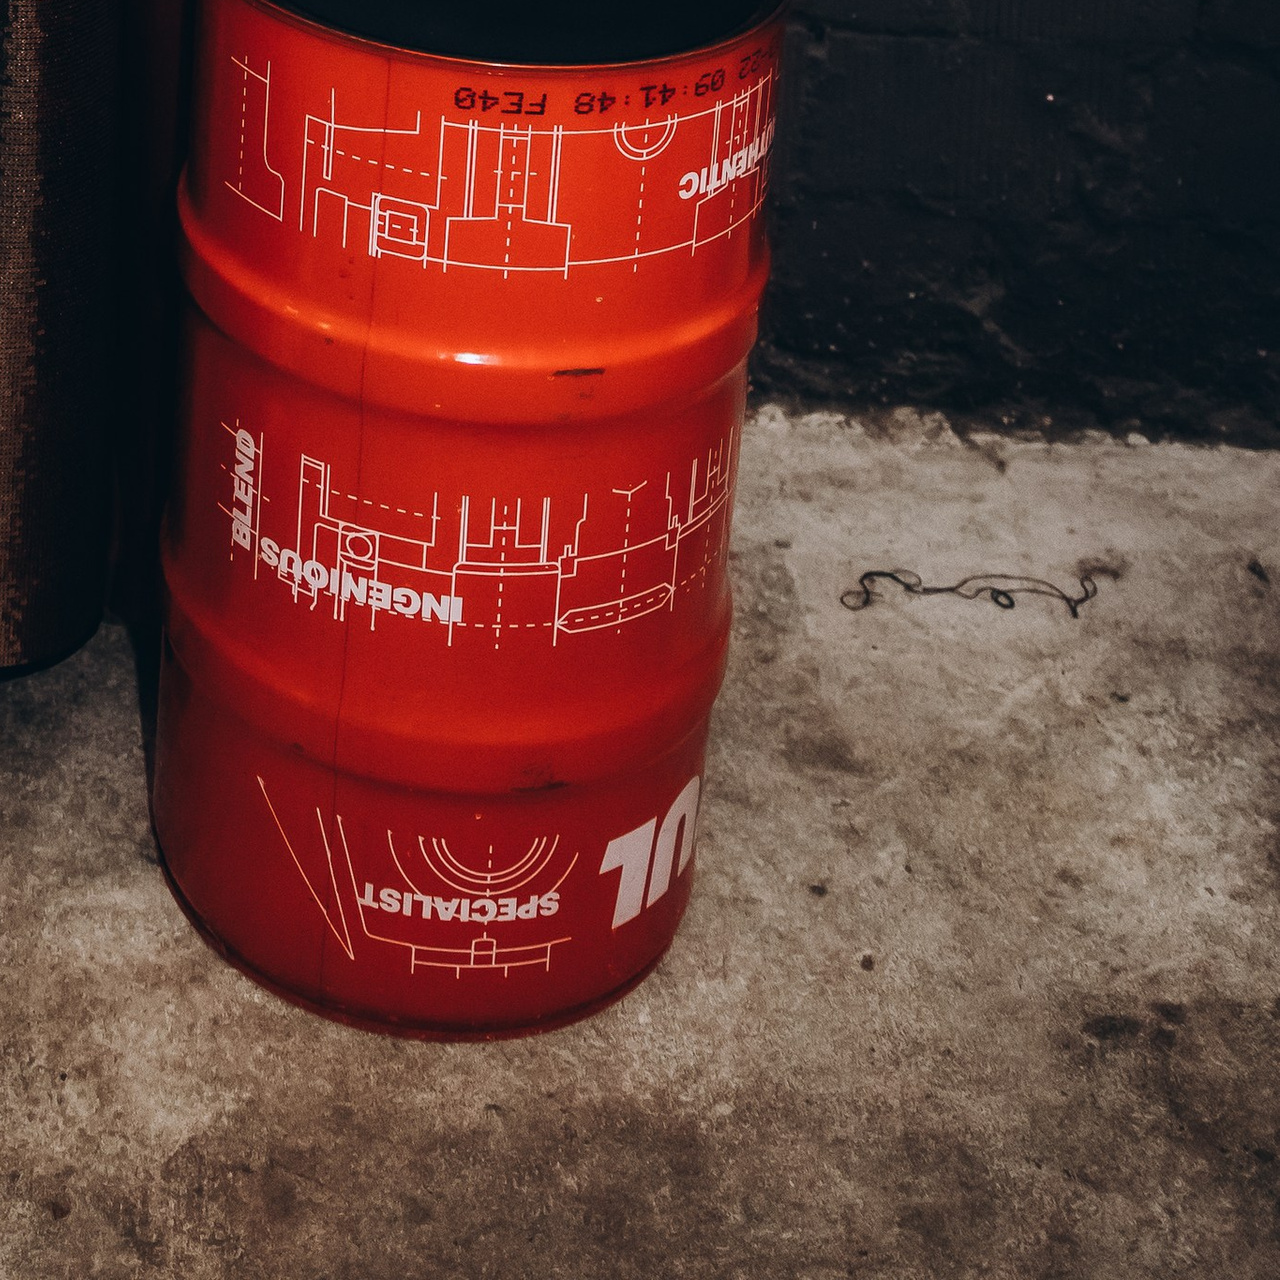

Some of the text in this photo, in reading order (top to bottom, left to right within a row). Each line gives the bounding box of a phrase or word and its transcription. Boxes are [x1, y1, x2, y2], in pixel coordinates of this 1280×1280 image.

[453, 86, 547, 116] FE40
[574, 68, 725, 116] 09:41:48
[231, 428, 256, 552] BLEND
[260, 537, 463, 623] INGENIOUS
[359, 882, 560, 922] SPECIALIST
